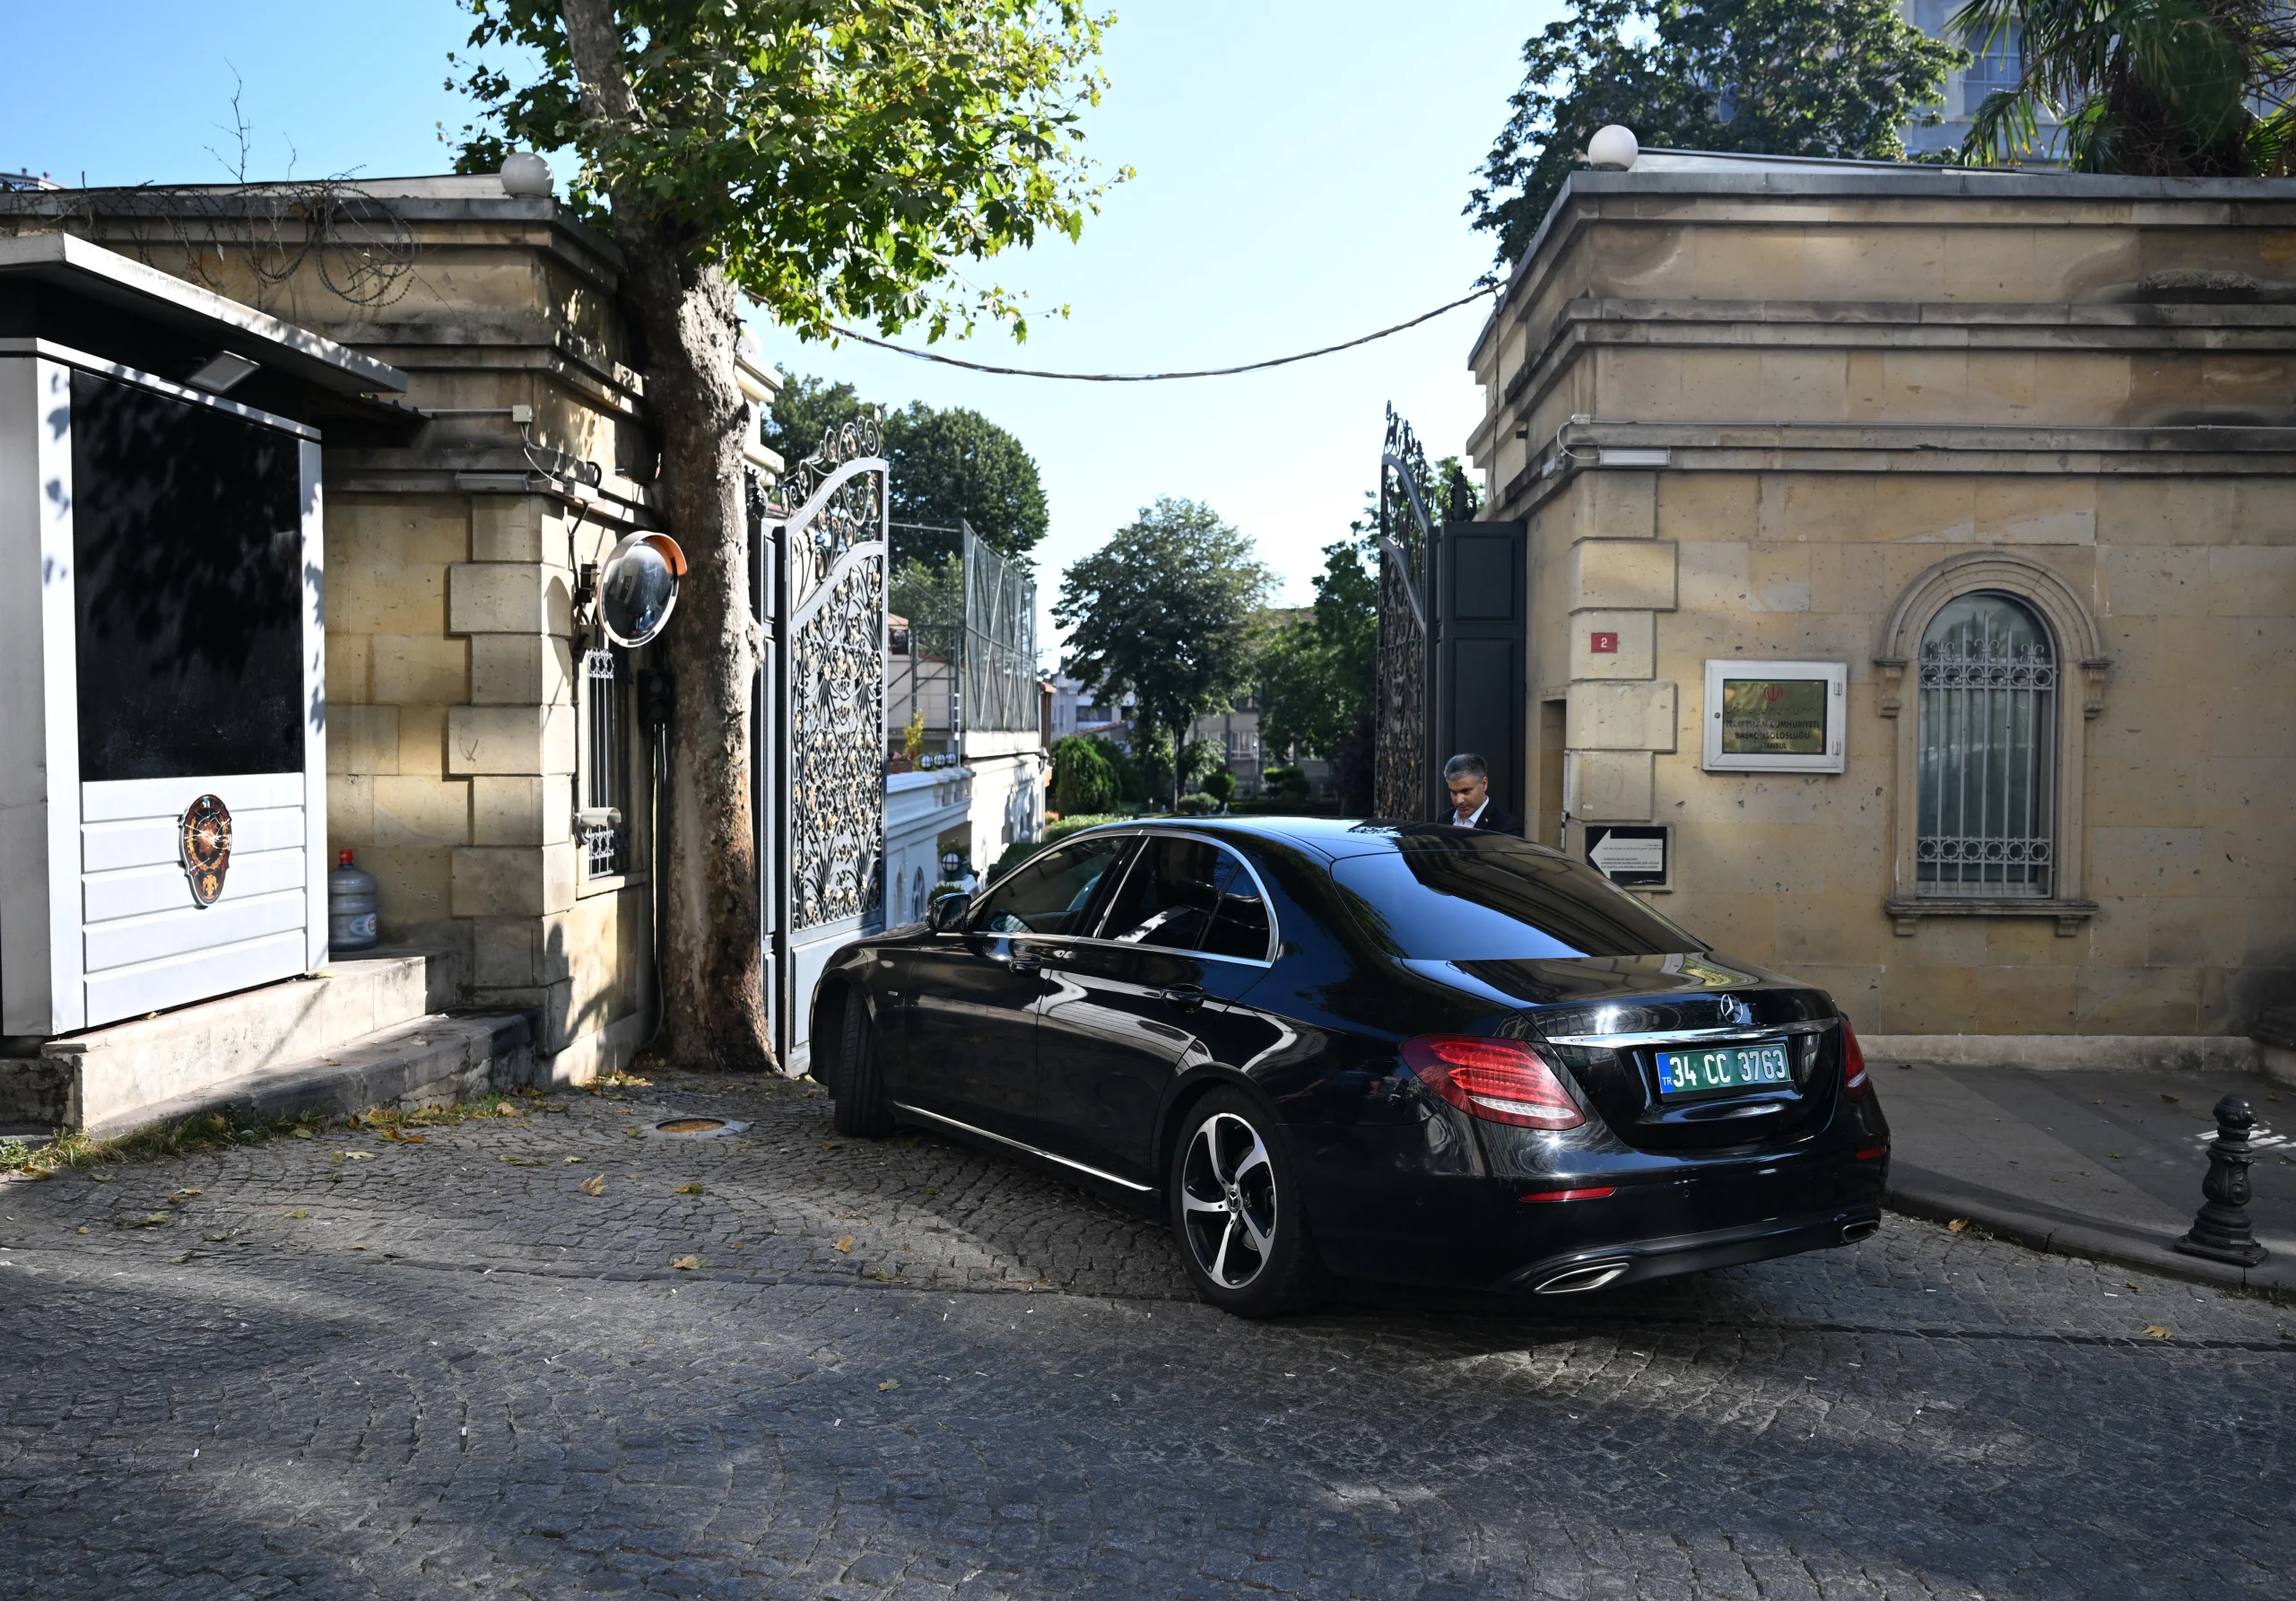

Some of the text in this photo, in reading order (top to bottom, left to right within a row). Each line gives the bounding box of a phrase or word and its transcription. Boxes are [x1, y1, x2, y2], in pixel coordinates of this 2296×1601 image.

[1601, 637, 1608, 648] 2
[1669, 1049, 1786, 1088] 34 CC 3763
[1662, 1077, 1673, 1086] TR
